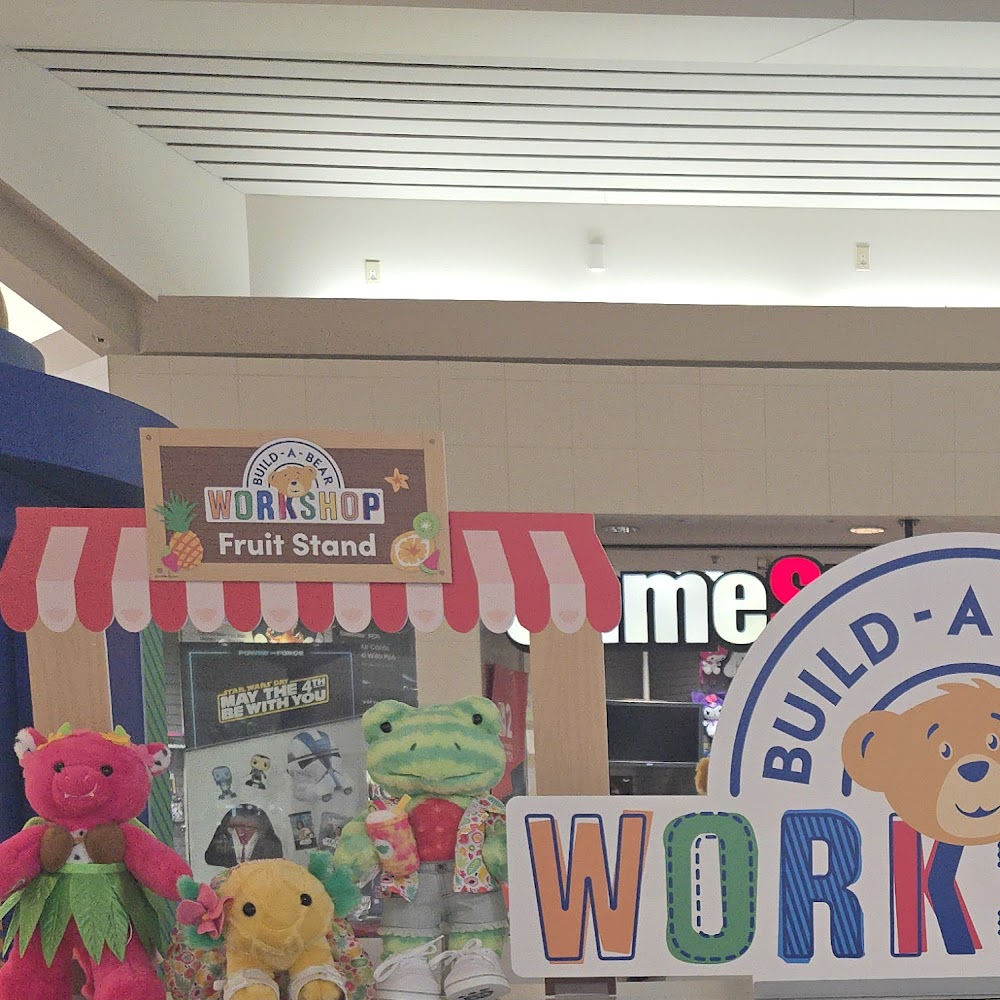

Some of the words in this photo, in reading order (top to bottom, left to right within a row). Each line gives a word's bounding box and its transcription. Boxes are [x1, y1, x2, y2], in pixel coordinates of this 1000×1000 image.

[207, 490, 381, 521] WORKSHOP
[218, 532, 285, 556] Fruit
[292, 532, 377, 557] Stand
[220, 689, 259, 708] MAY
[262, 683, 298, 700] THE
[301, 677, 326, 694] 4TH
[246, 682, 272, 691] WARS
[273, 678, 289, 687] DAY
[221, 705, 244, 720] BE
[246, 696, 290, 714] WITH
[292, 689, 326, 706] YOU
